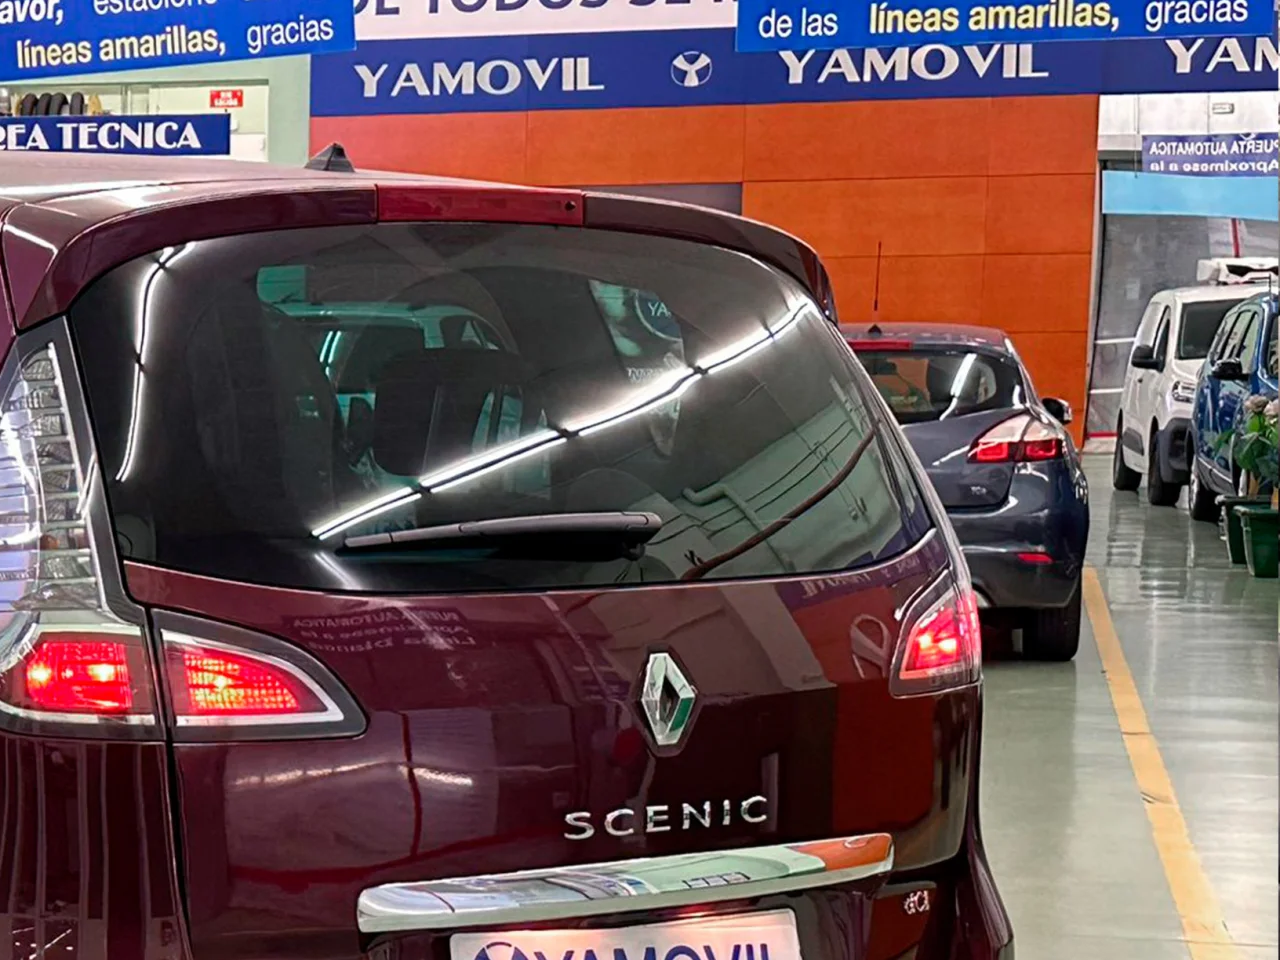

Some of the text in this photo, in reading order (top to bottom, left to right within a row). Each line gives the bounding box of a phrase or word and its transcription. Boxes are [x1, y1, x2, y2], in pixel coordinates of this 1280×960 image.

[94, 0, 218, 15] estac
[759, 8, 792, 38] de
[801, 7, 838, 36] las
[870, 2, 959, 34] líneas
[968, 0, 1120, 33] amarillas,
[1145, 0, 1249, 32] gracias
[17, 39, 91, 69] líneas
[100, 25, 226, 61] amarillas,
[246, 14, 334, 53] gracias
[1165, 36, 1278, 73] YAM
[354, 56, 605, 98] YAMOVIL
[778, 43, 1050, 84] YAMOVIL
[56, 121, 202, 151] TECNICA
[564, 795, 768, 840] SCENIC
